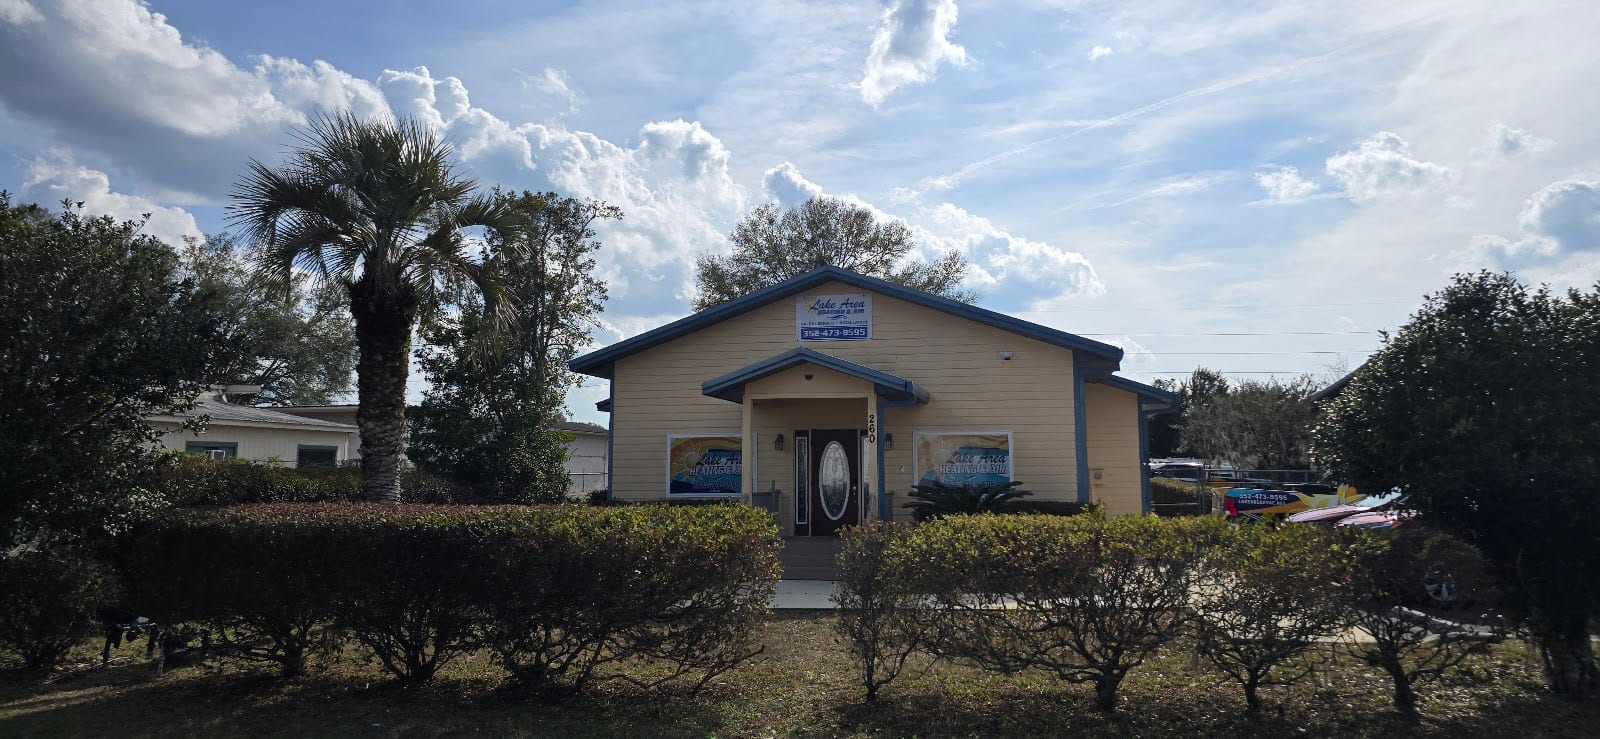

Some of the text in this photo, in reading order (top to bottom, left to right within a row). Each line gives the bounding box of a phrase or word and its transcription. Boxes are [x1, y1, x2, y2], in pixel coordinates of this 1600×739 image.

[810, 298, 865, 310] Lake Area
[803, 328, 866, 337] 352-473-9595
[696, 453, 742, 466] Lake Are
[946, 451, 1007, 464] Lake Area
[689, 466, 723, 475] HEATING
[939, 464, 977, 474] HEATING
[990, 464, 1009, 474] AIR
